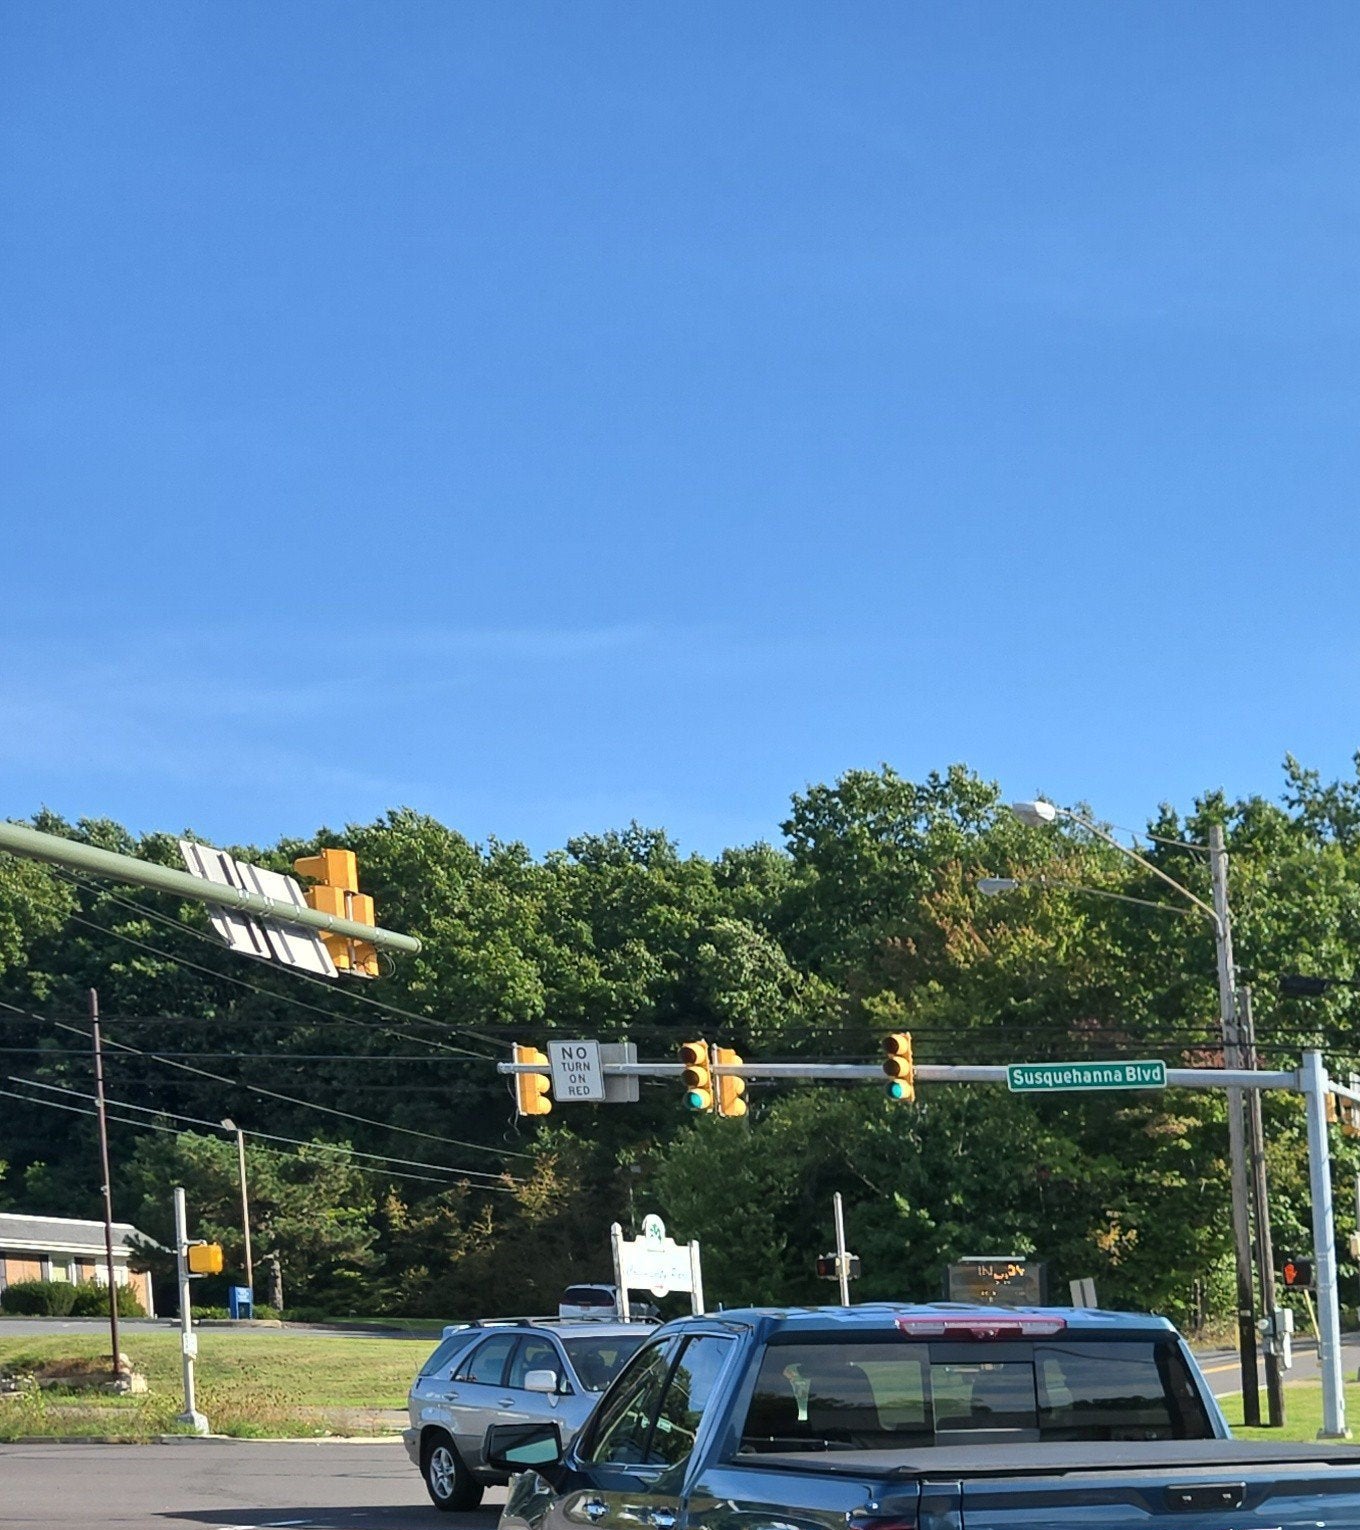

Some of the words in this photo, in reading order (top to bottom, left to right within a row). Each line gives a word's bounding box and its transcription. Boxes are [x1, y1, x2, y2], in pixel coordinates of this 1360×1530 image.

[561, 1047, 587, 1060] NO
[561, 1062, 591, 1072] TURN
[569, 1074, 586, 1084] ON
[1013, 1068, 1122, 1087] Susquehanna
[1125, 1066, 1161, 1081] Blvd
[568, 1086, 590, 1096] RED
